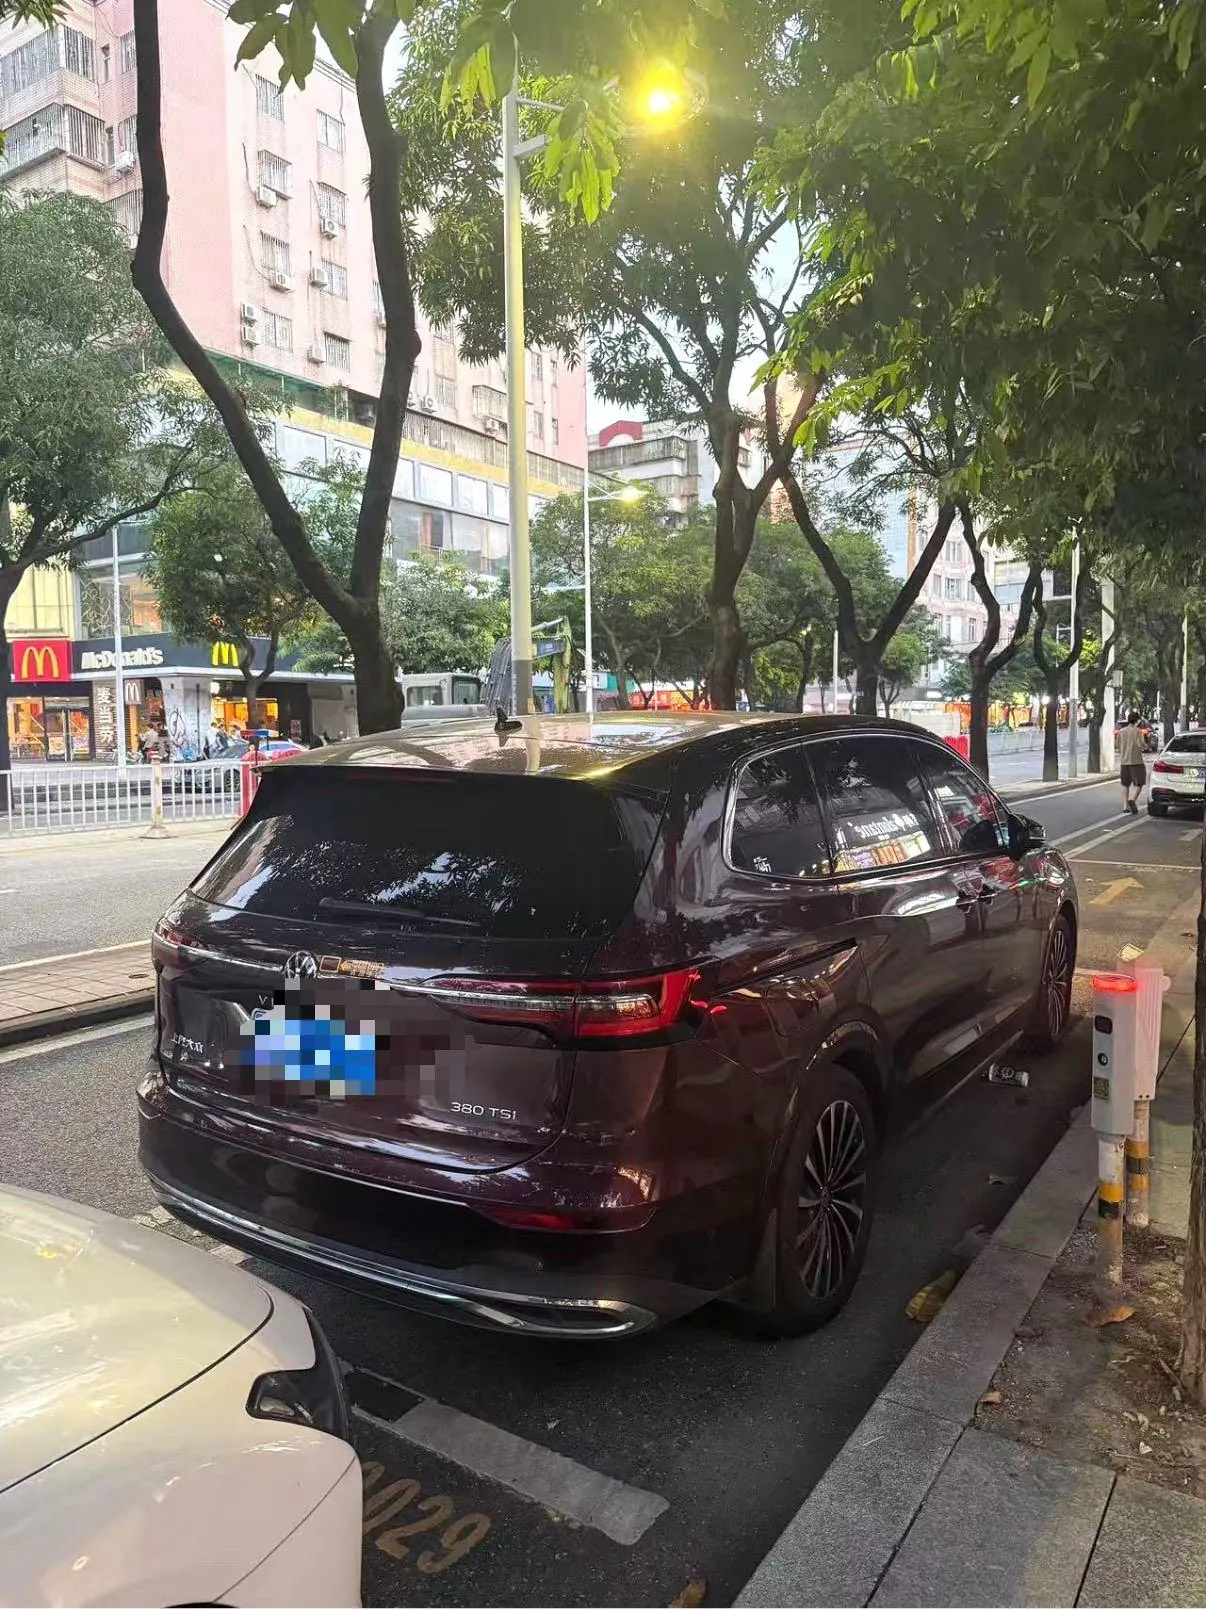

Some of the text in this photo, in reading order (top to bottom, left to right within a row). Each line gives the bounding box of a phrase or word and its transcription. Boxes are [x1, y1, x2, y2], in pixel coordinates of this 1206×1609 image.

[97, 687, 115, 743] 麦当劳
[450, 1101, 517, 1120] 380 TSI
[362, 1461, 492, 1574] 029
